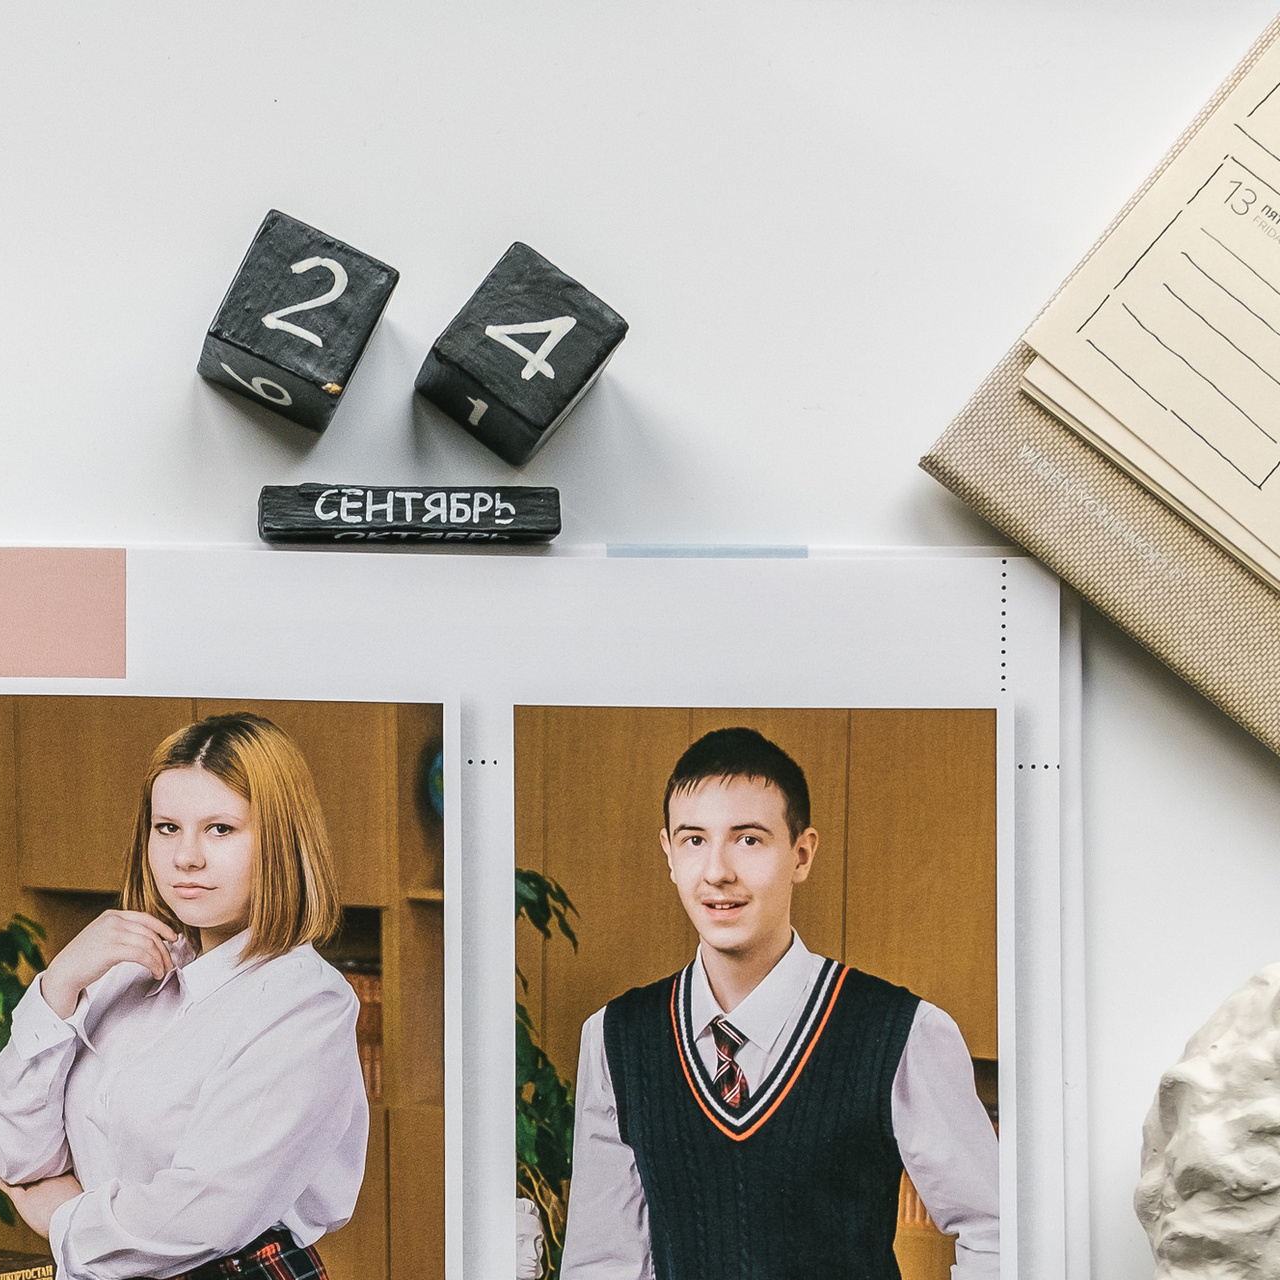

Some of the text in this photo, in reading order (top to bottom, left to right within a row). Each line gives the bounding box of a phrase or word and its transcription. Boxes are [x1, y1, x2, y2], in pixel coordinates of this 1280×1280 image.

[1224, 180, 1257, 215] 13
[261, 255, 349, 348] 2
[485, 315, 577, 381] 4
[314, 488, 516, 526] СЕНТЯБРЬ
